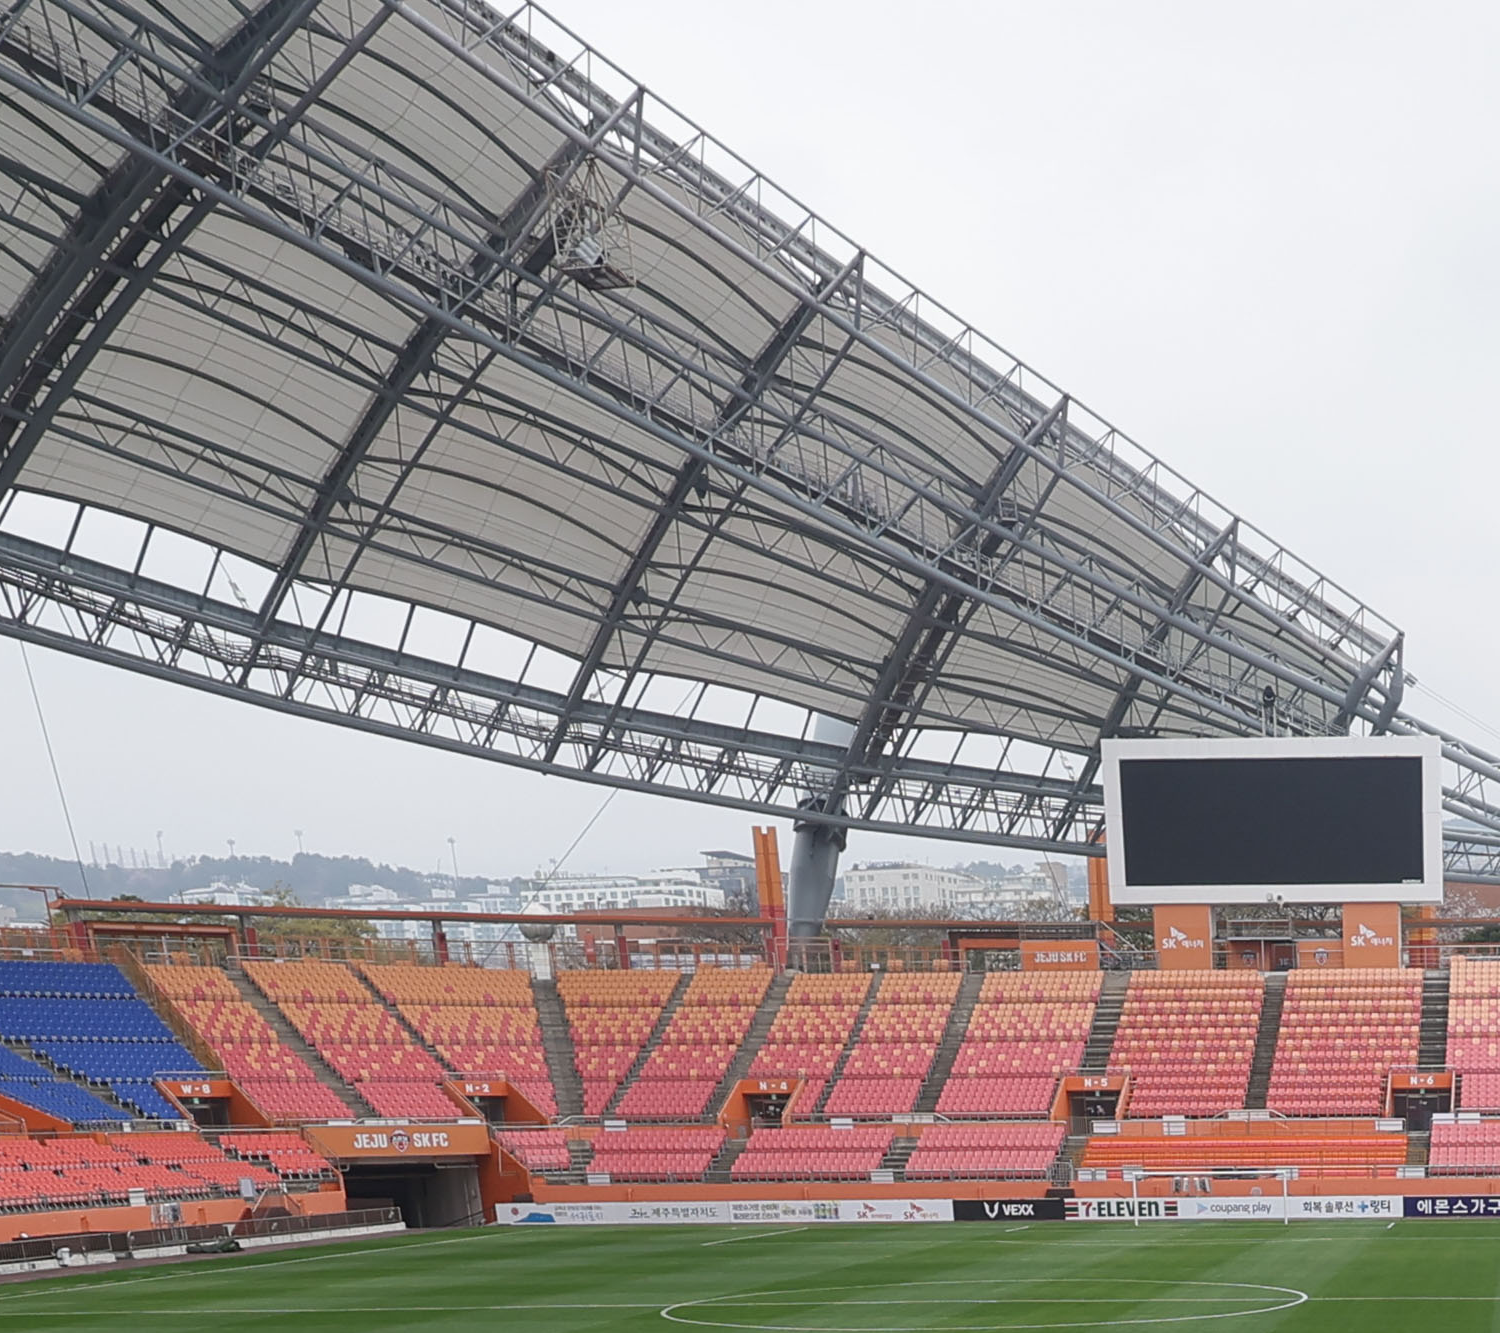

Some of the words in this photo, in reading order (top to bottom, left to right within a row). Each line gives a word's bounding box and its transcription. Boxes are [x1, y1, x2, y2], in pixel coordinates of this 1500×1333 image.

[1162, 938, 1177, 949] SK
[1351, 935, 1365, 946] SK
[354, 1132, 388, 1149] JEJU
[413, 1133, 431, 1148] SK
[432, 1132, 449, 1148] FC
[651, 1207, 718, 1218] 제주특별자치도
[1002, 1204, 1034, 1216] VEXX
[1081, 1201, 1160, 1217] 7-ELEVEN
[1210, 1203, 1250, 1214] coupang
[1252, 1202, 1271, 1214] play
[1303, 1201, 1322, 1213] 회복
[1325, 1201, 1354, 1213] 솔루션
[857, 1211, 868, 1219] SK
[903, 1211, 915, 1219] SK
